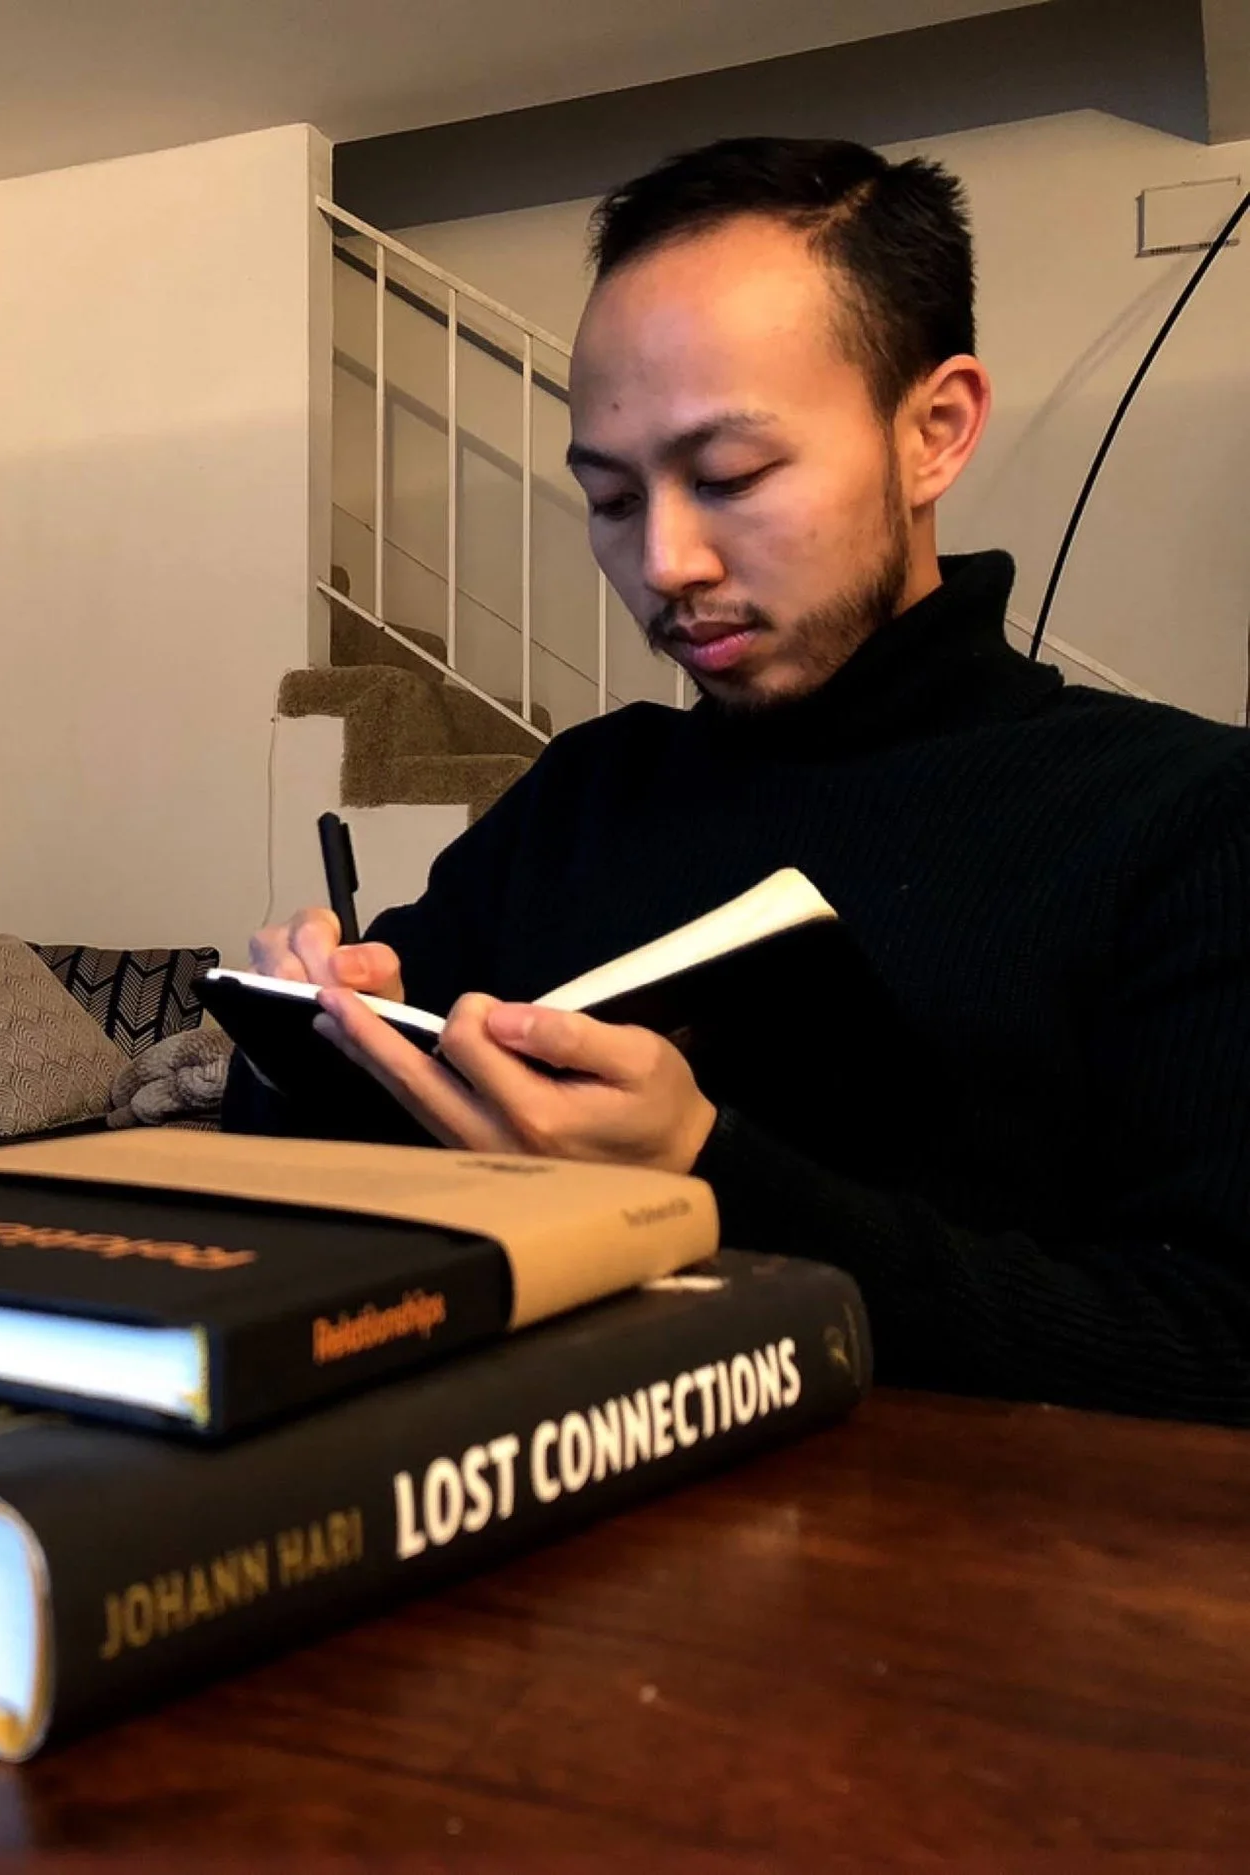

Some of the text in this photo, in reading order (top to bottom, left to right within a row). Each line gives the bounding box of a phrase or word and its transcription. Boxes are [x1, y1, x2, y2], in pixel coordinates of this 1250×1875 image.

[393, 1336, 802, 1560] LOST CONNECTIONS
[100, 1507, 363, 1660] JOHANN HARI
